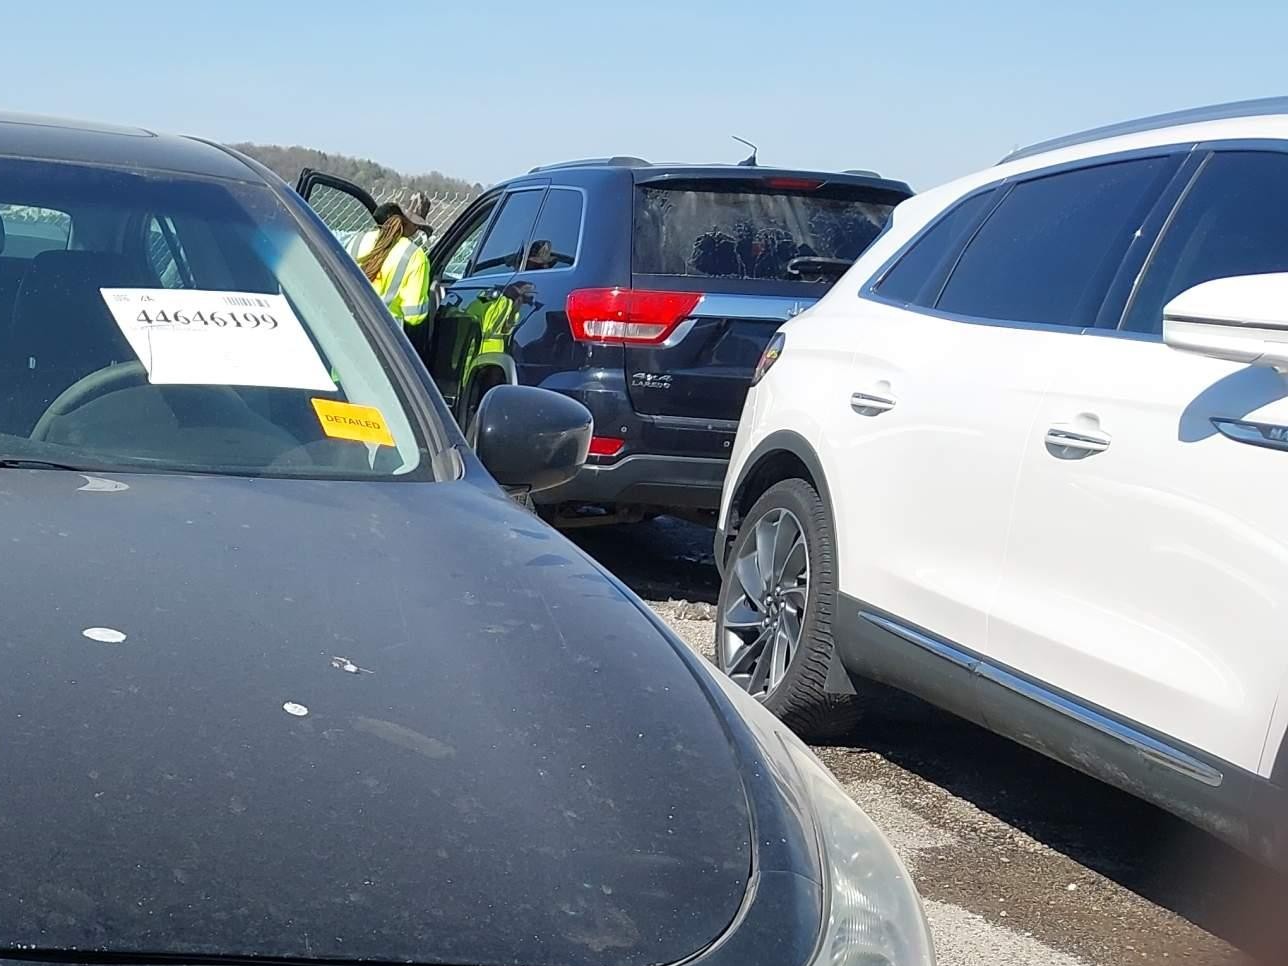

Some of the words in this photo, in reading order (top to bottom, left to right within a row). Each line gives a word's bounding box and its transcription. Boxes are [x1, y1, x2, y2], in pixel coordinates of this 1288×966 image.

[136, 309, 279, 330] 44646199
[632, 380, 671, 389] LAREDO
[325, 414, 381, 430] DETAILED
